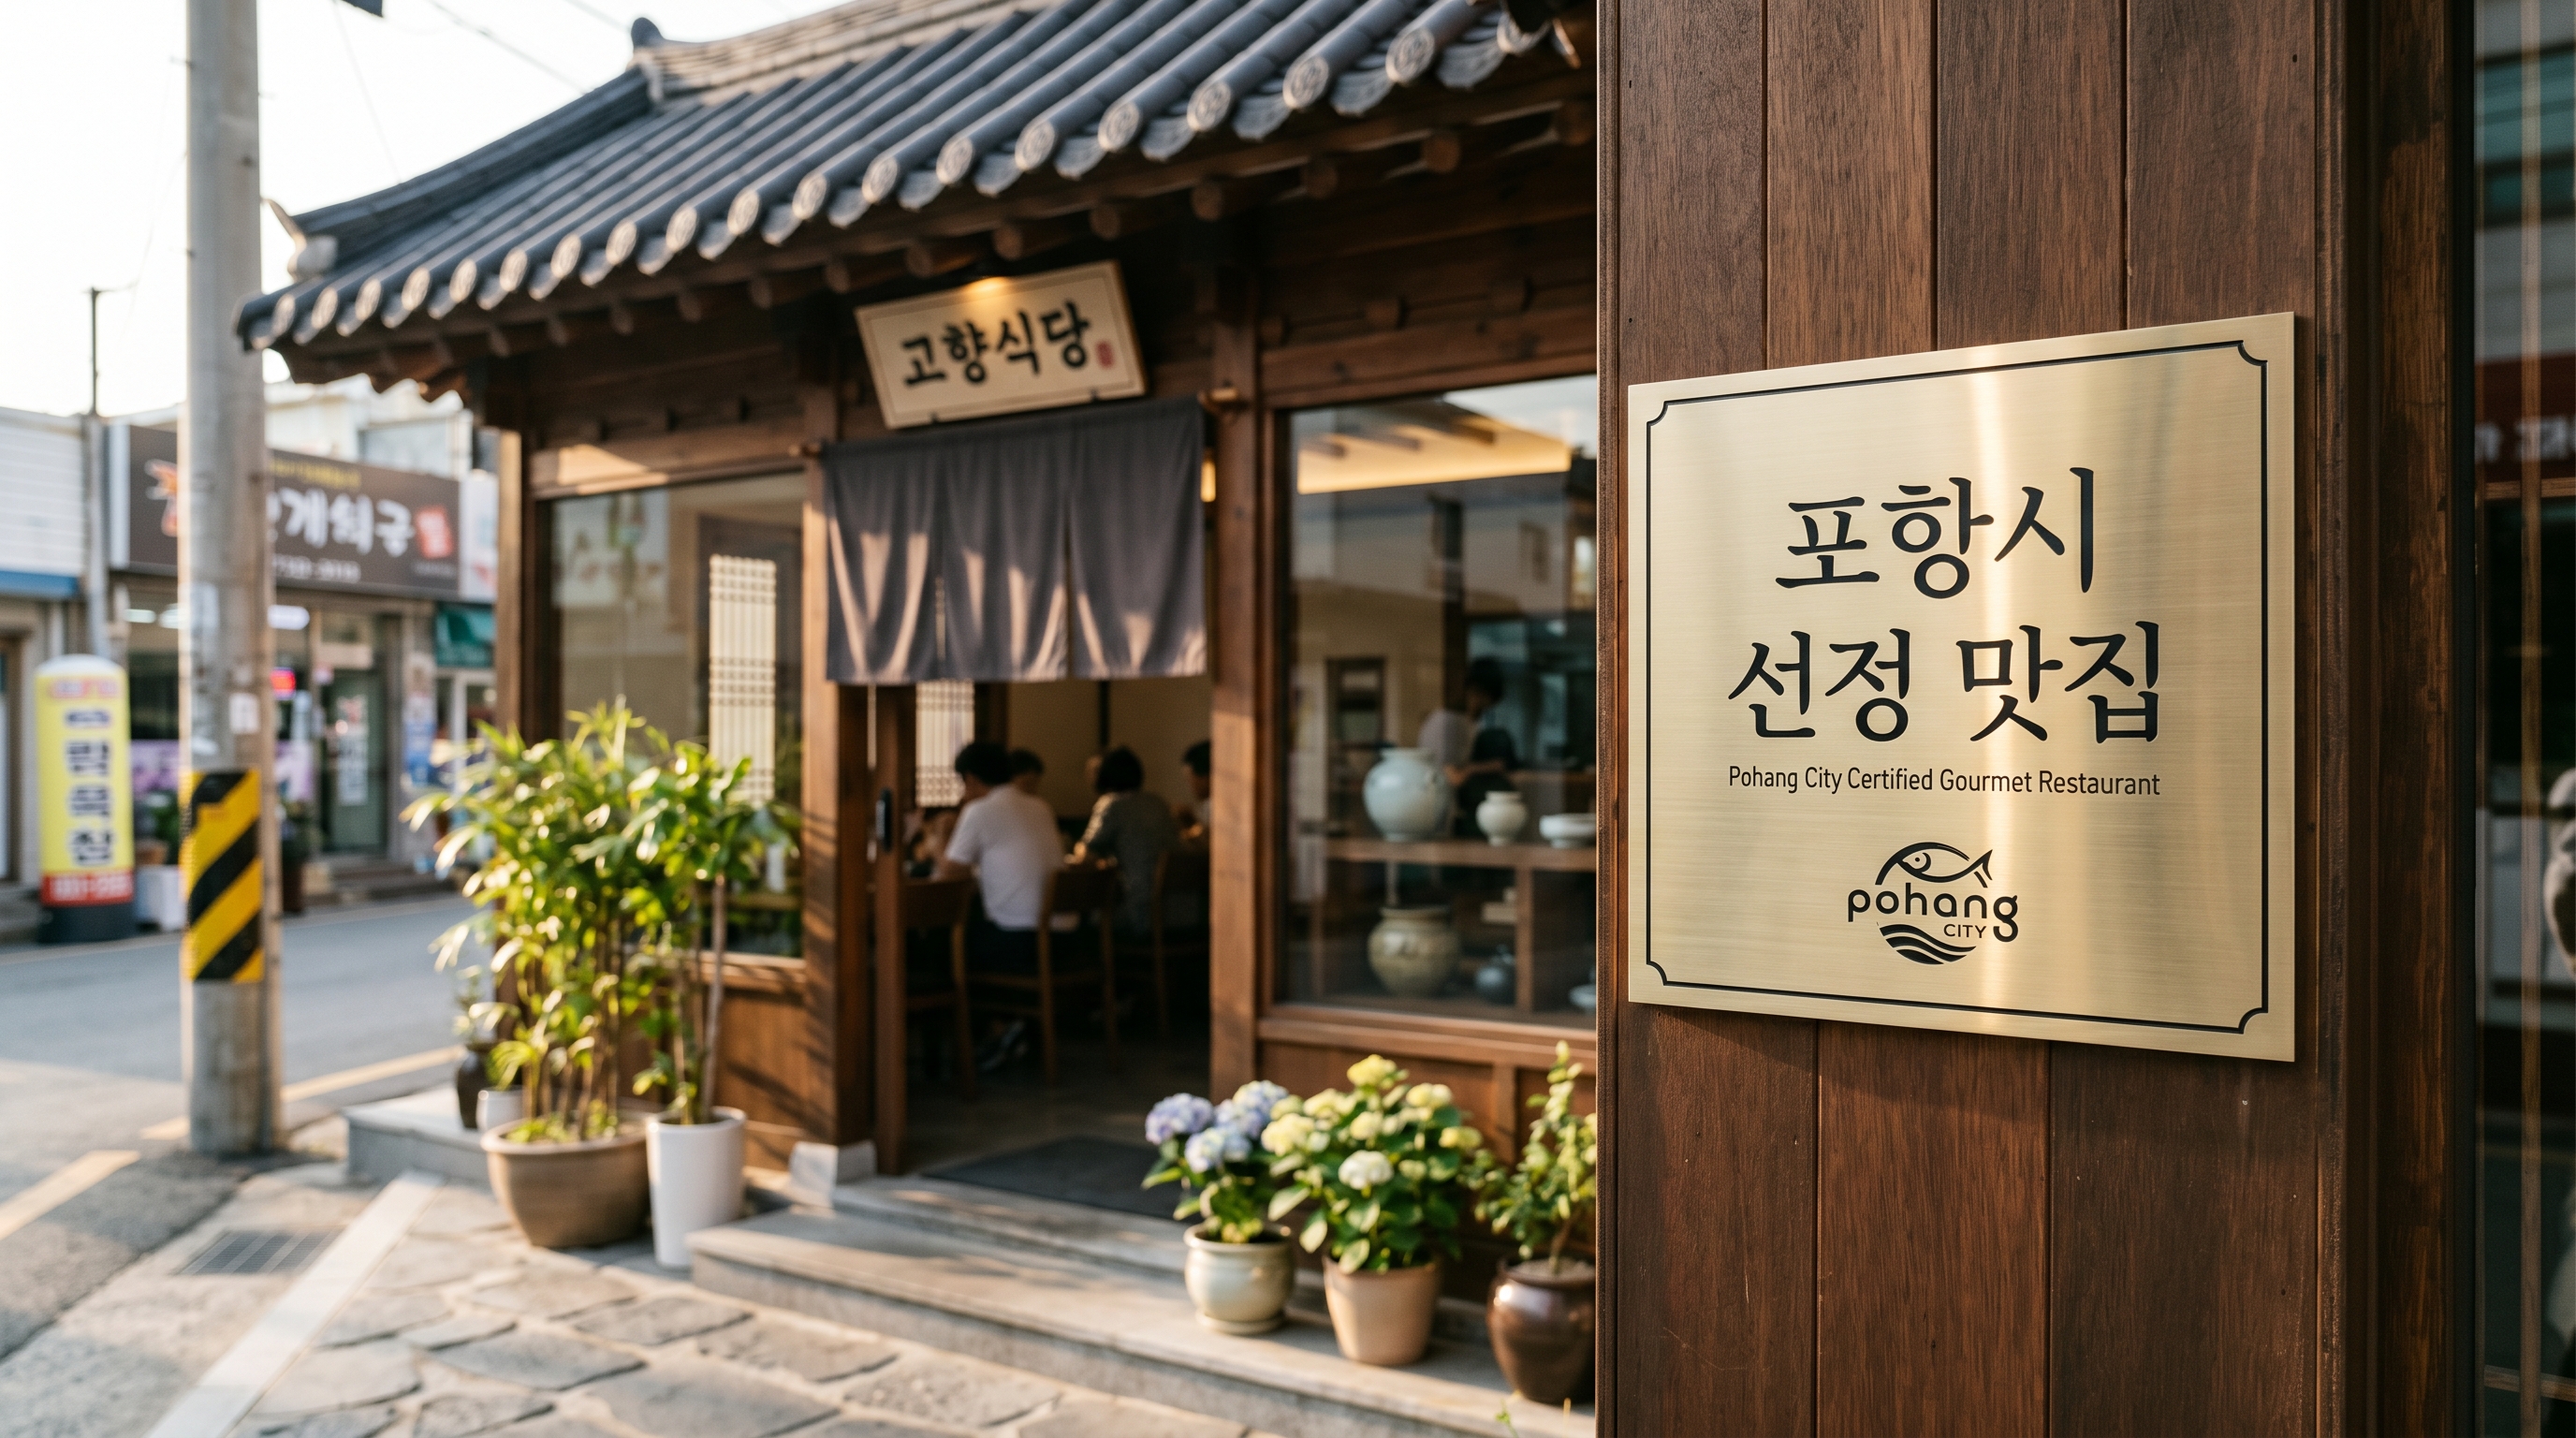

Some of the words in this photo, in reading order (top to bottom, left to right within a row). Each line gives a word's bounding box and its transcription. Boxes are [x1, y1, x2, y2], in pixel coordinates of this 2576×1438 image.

[900, 299, 1091, 388] 고향식당
[1775, 466, 2095, 600] 포항시
[1728, 628, 1910, 742] 선정
[1955, 620, 2159, 744] 맛집
[1729, 765, 1798, 795] Pohang
[1805, 766, 1843, 795] City
[1848, 767, 1933, 791] Certified
[1939, 768, 2032, 794] Gourmet
[2039, 770, 2160, 796] Restaurant
[1848, 882, 2019, 943] pohang
[1943, 923, 1986, 939] CITY
